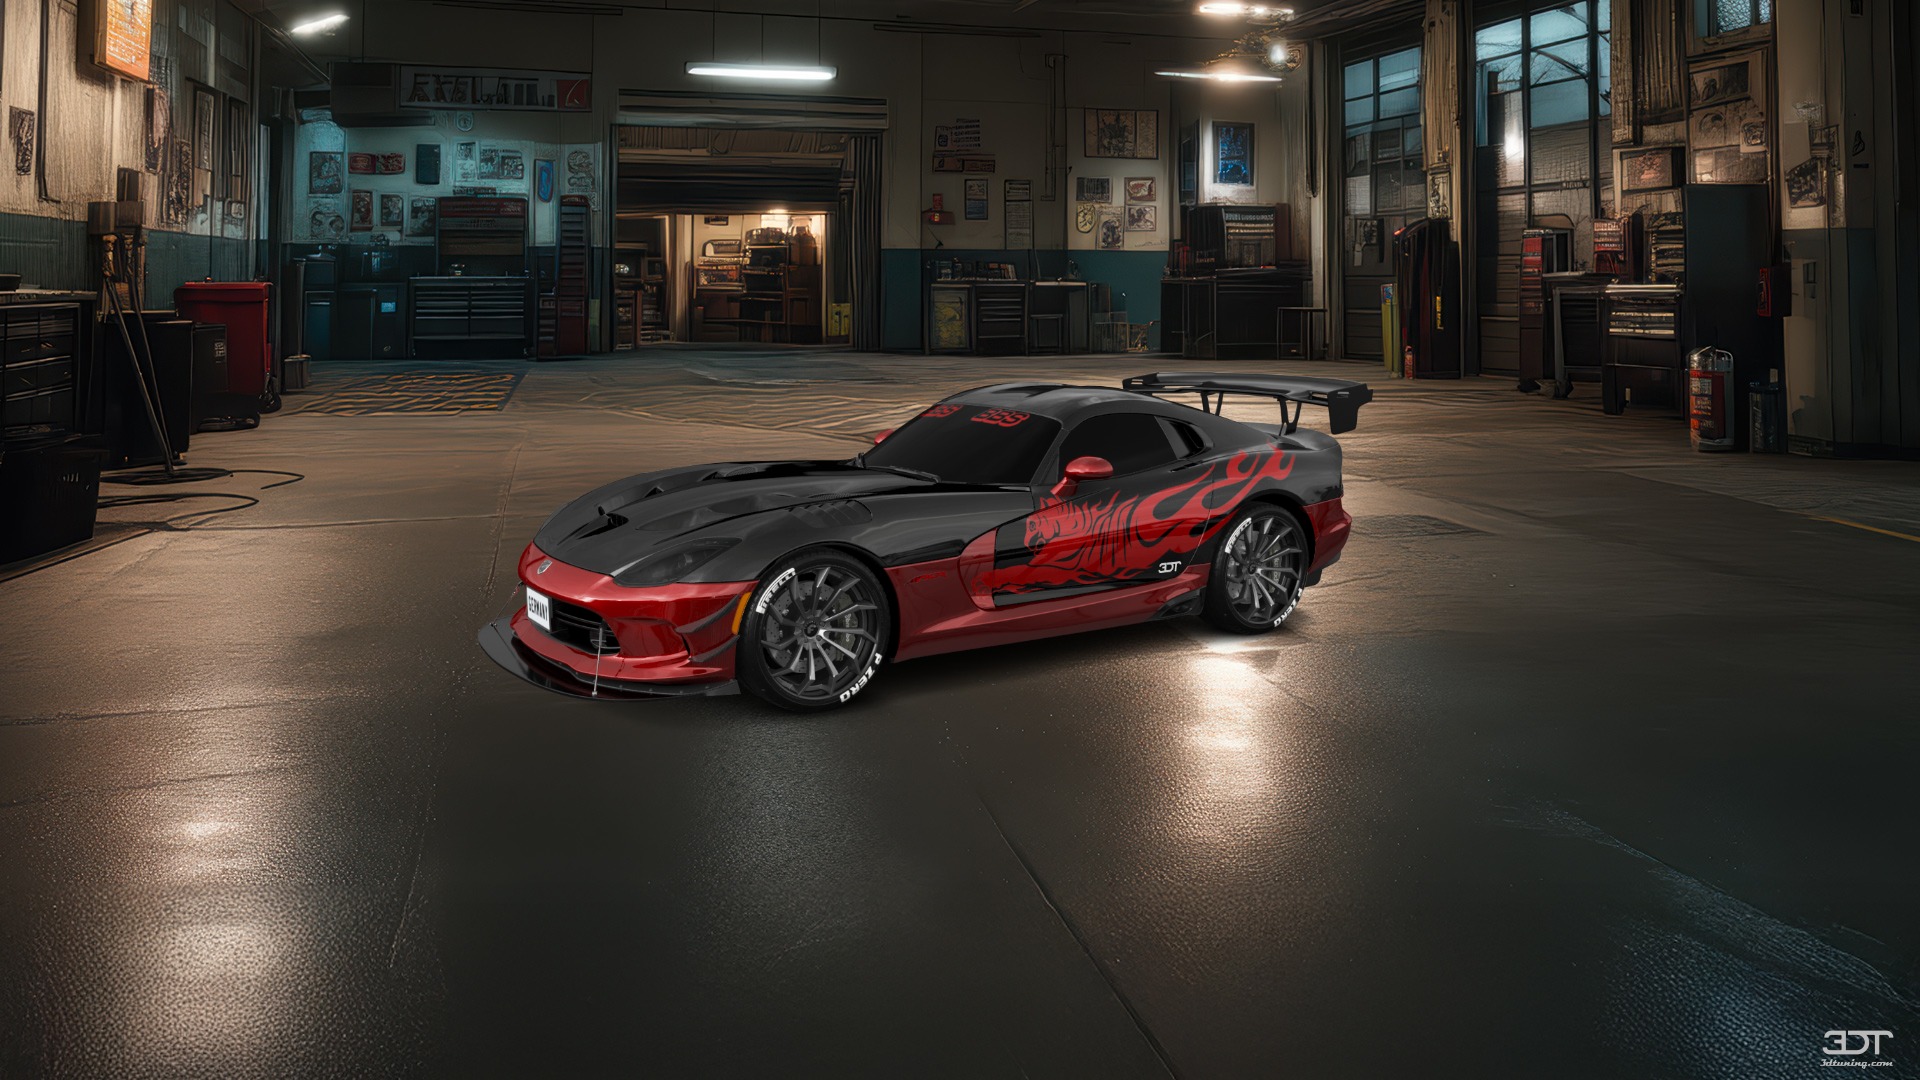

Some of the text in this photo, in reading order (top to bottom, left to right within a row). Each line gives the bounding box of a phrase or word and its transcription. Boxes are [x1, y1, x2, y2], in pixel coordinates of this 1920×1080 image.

[1158, 561, 1182, 573] 3DT
[528, 595, 548, 621] GERMANY
[840, 653, 883, 702] P ZERO
